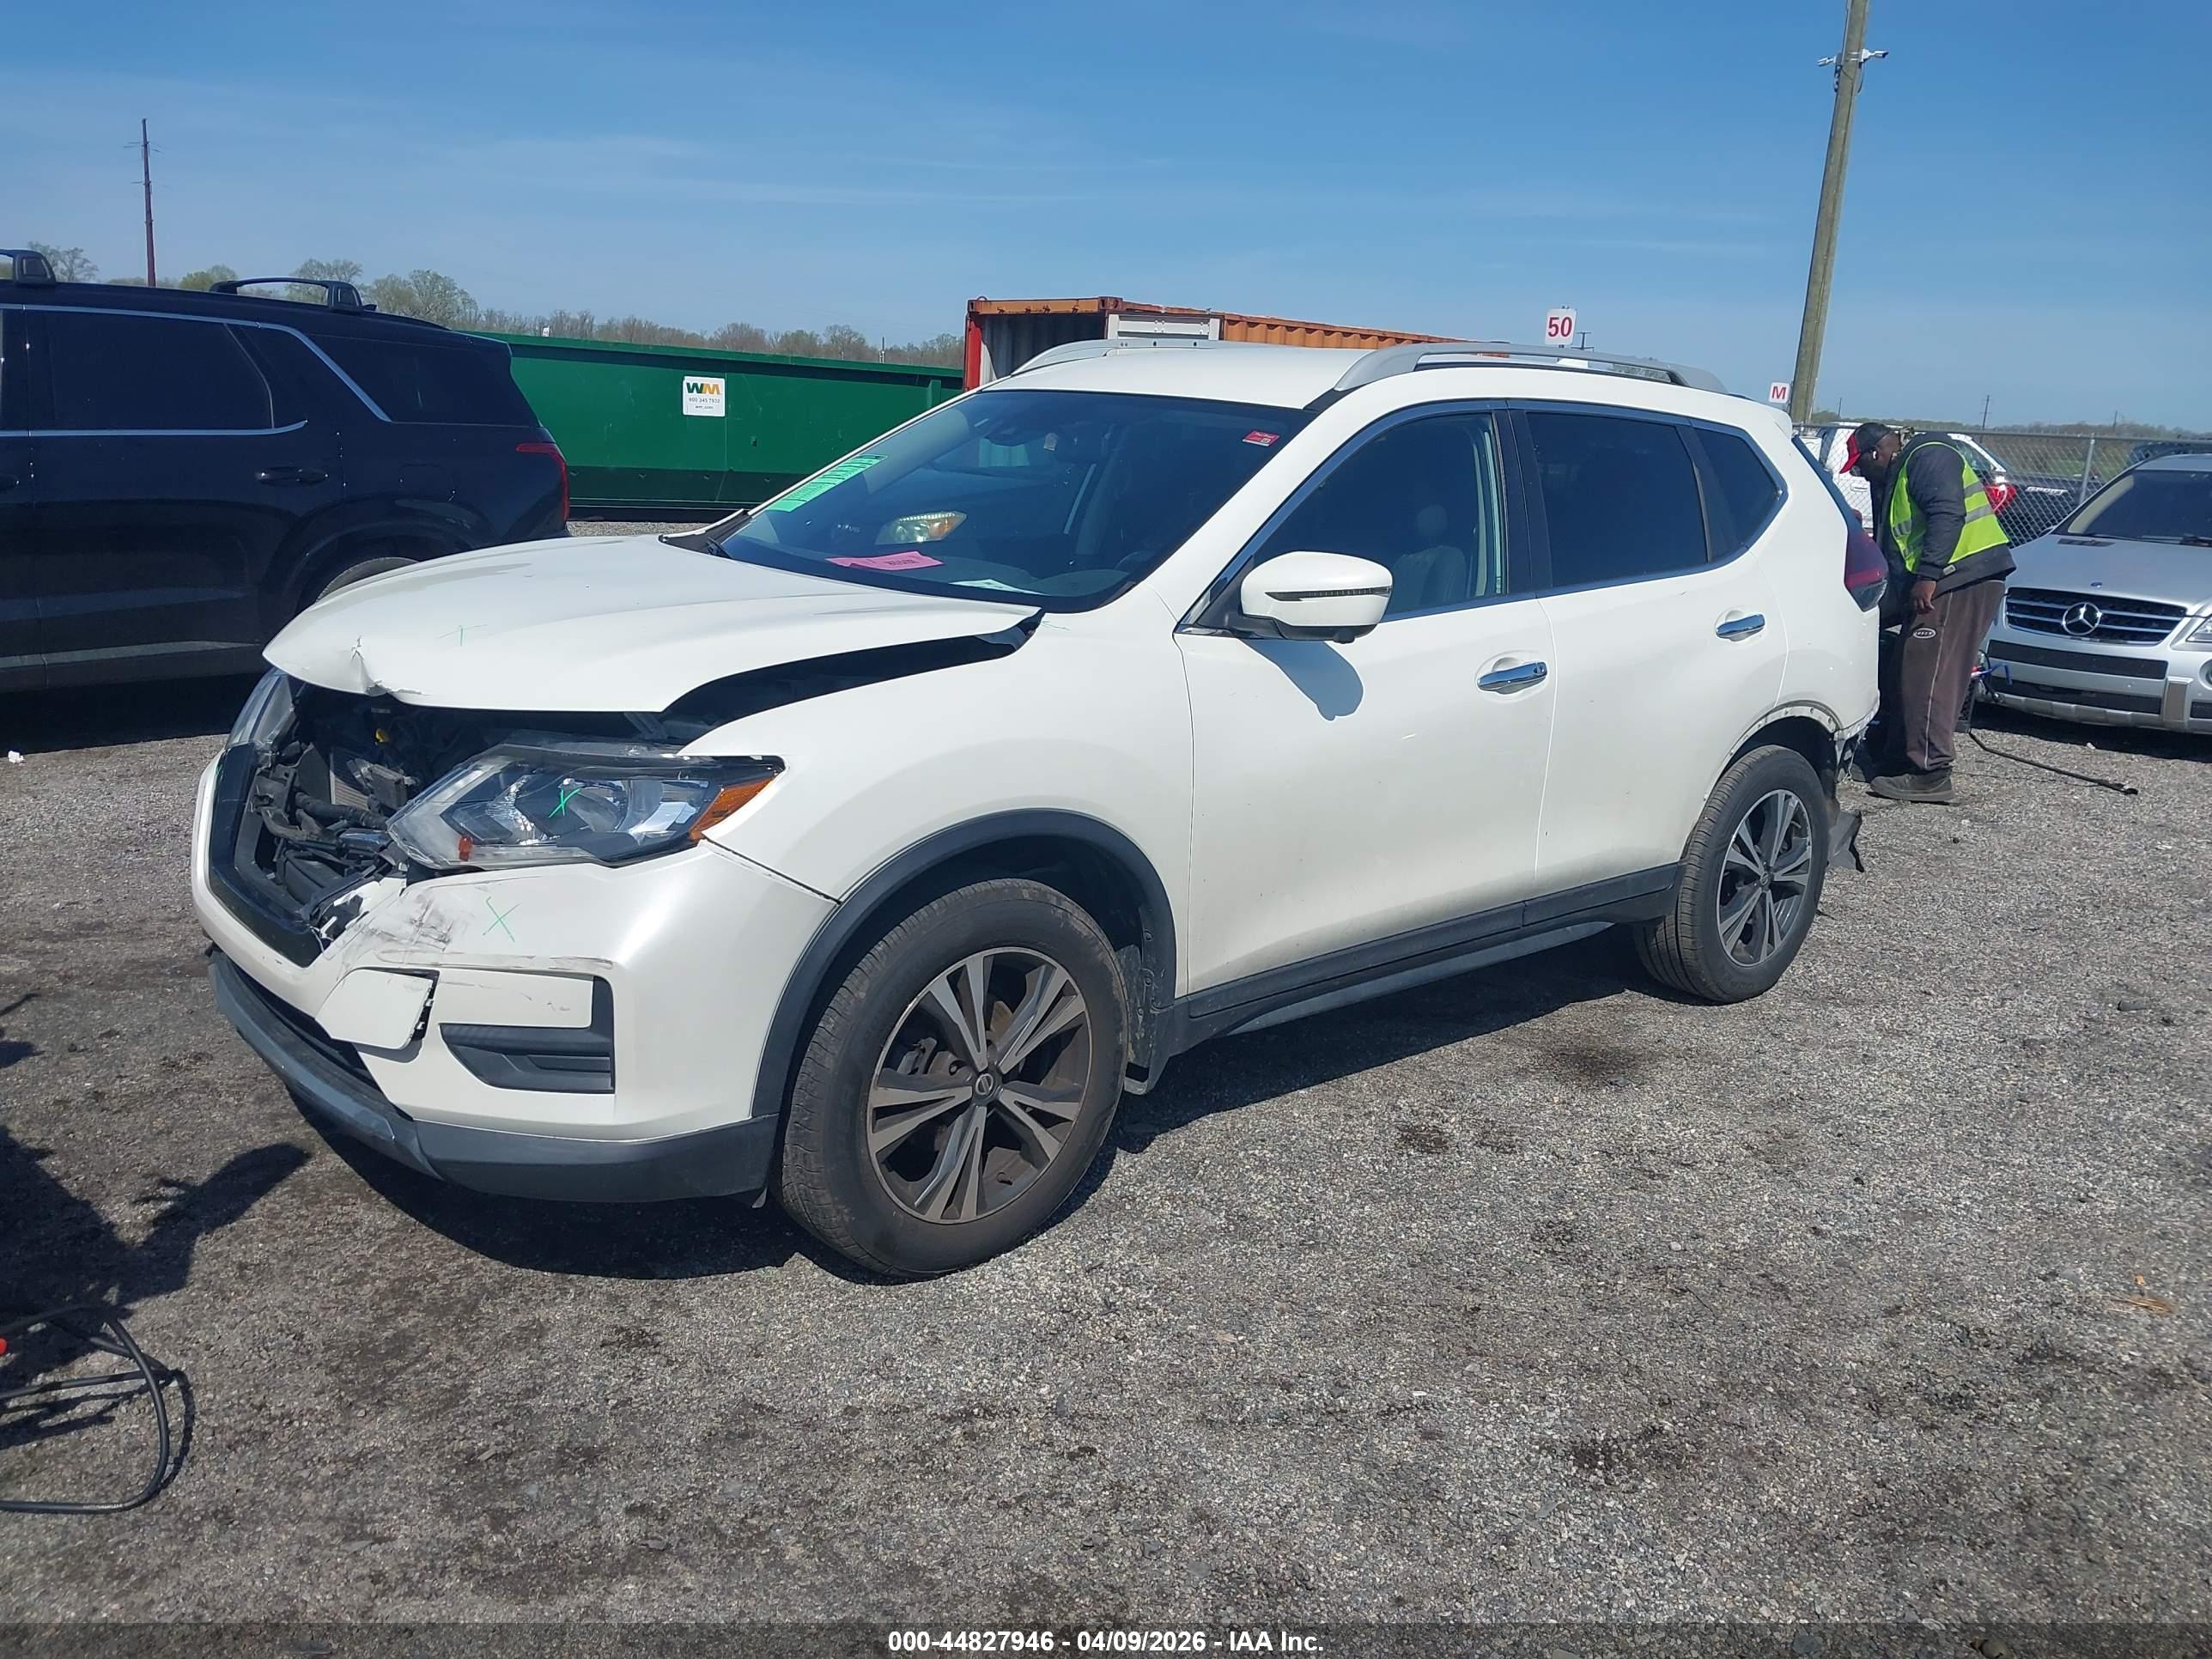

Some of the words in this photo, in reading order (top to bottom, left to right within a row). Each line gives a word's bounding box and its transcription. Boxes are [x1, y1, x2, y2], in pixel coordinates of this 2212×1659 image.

[1548, 316, 1572, 337] 50
[686, 382, 720, 395] WM
[1771, 386, 1786, 399] M
